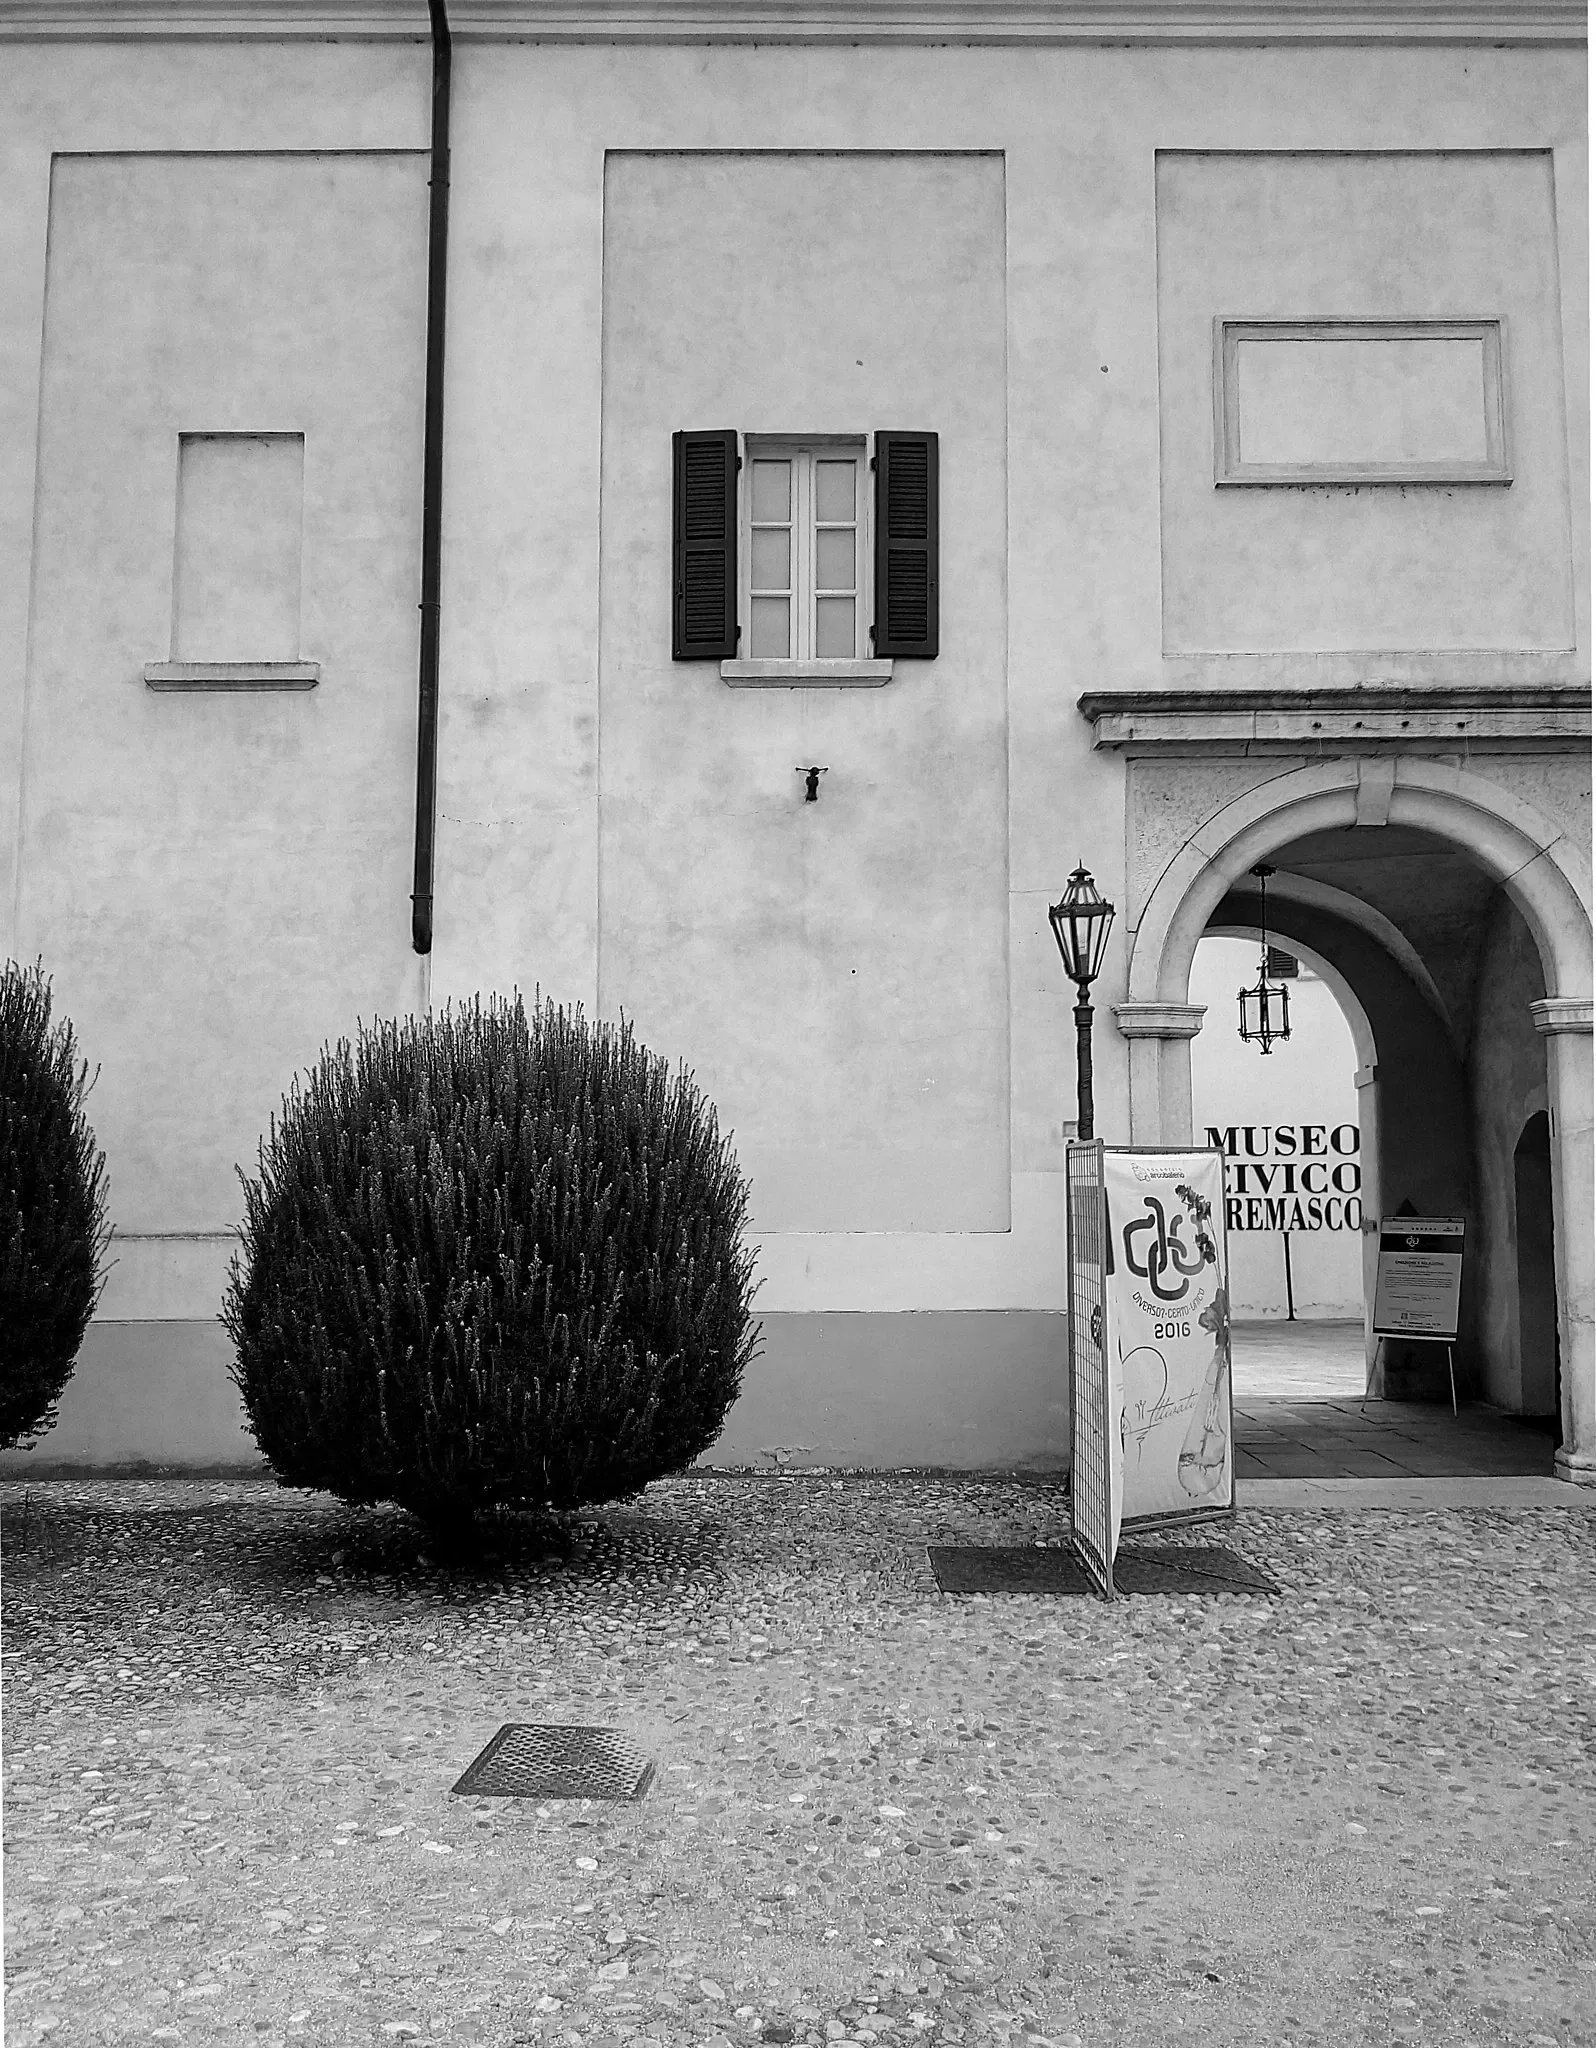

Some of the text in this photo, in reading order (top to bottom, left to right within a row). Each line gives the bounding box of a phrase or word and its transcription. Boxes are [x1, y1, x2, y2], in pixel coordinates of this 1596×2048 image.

[1204, 1124, 1360, 1157] MUSEO
[1226, 1197, 1362, 1231] REMASCO
[1154, 1321, 1191, 1339] 2016
